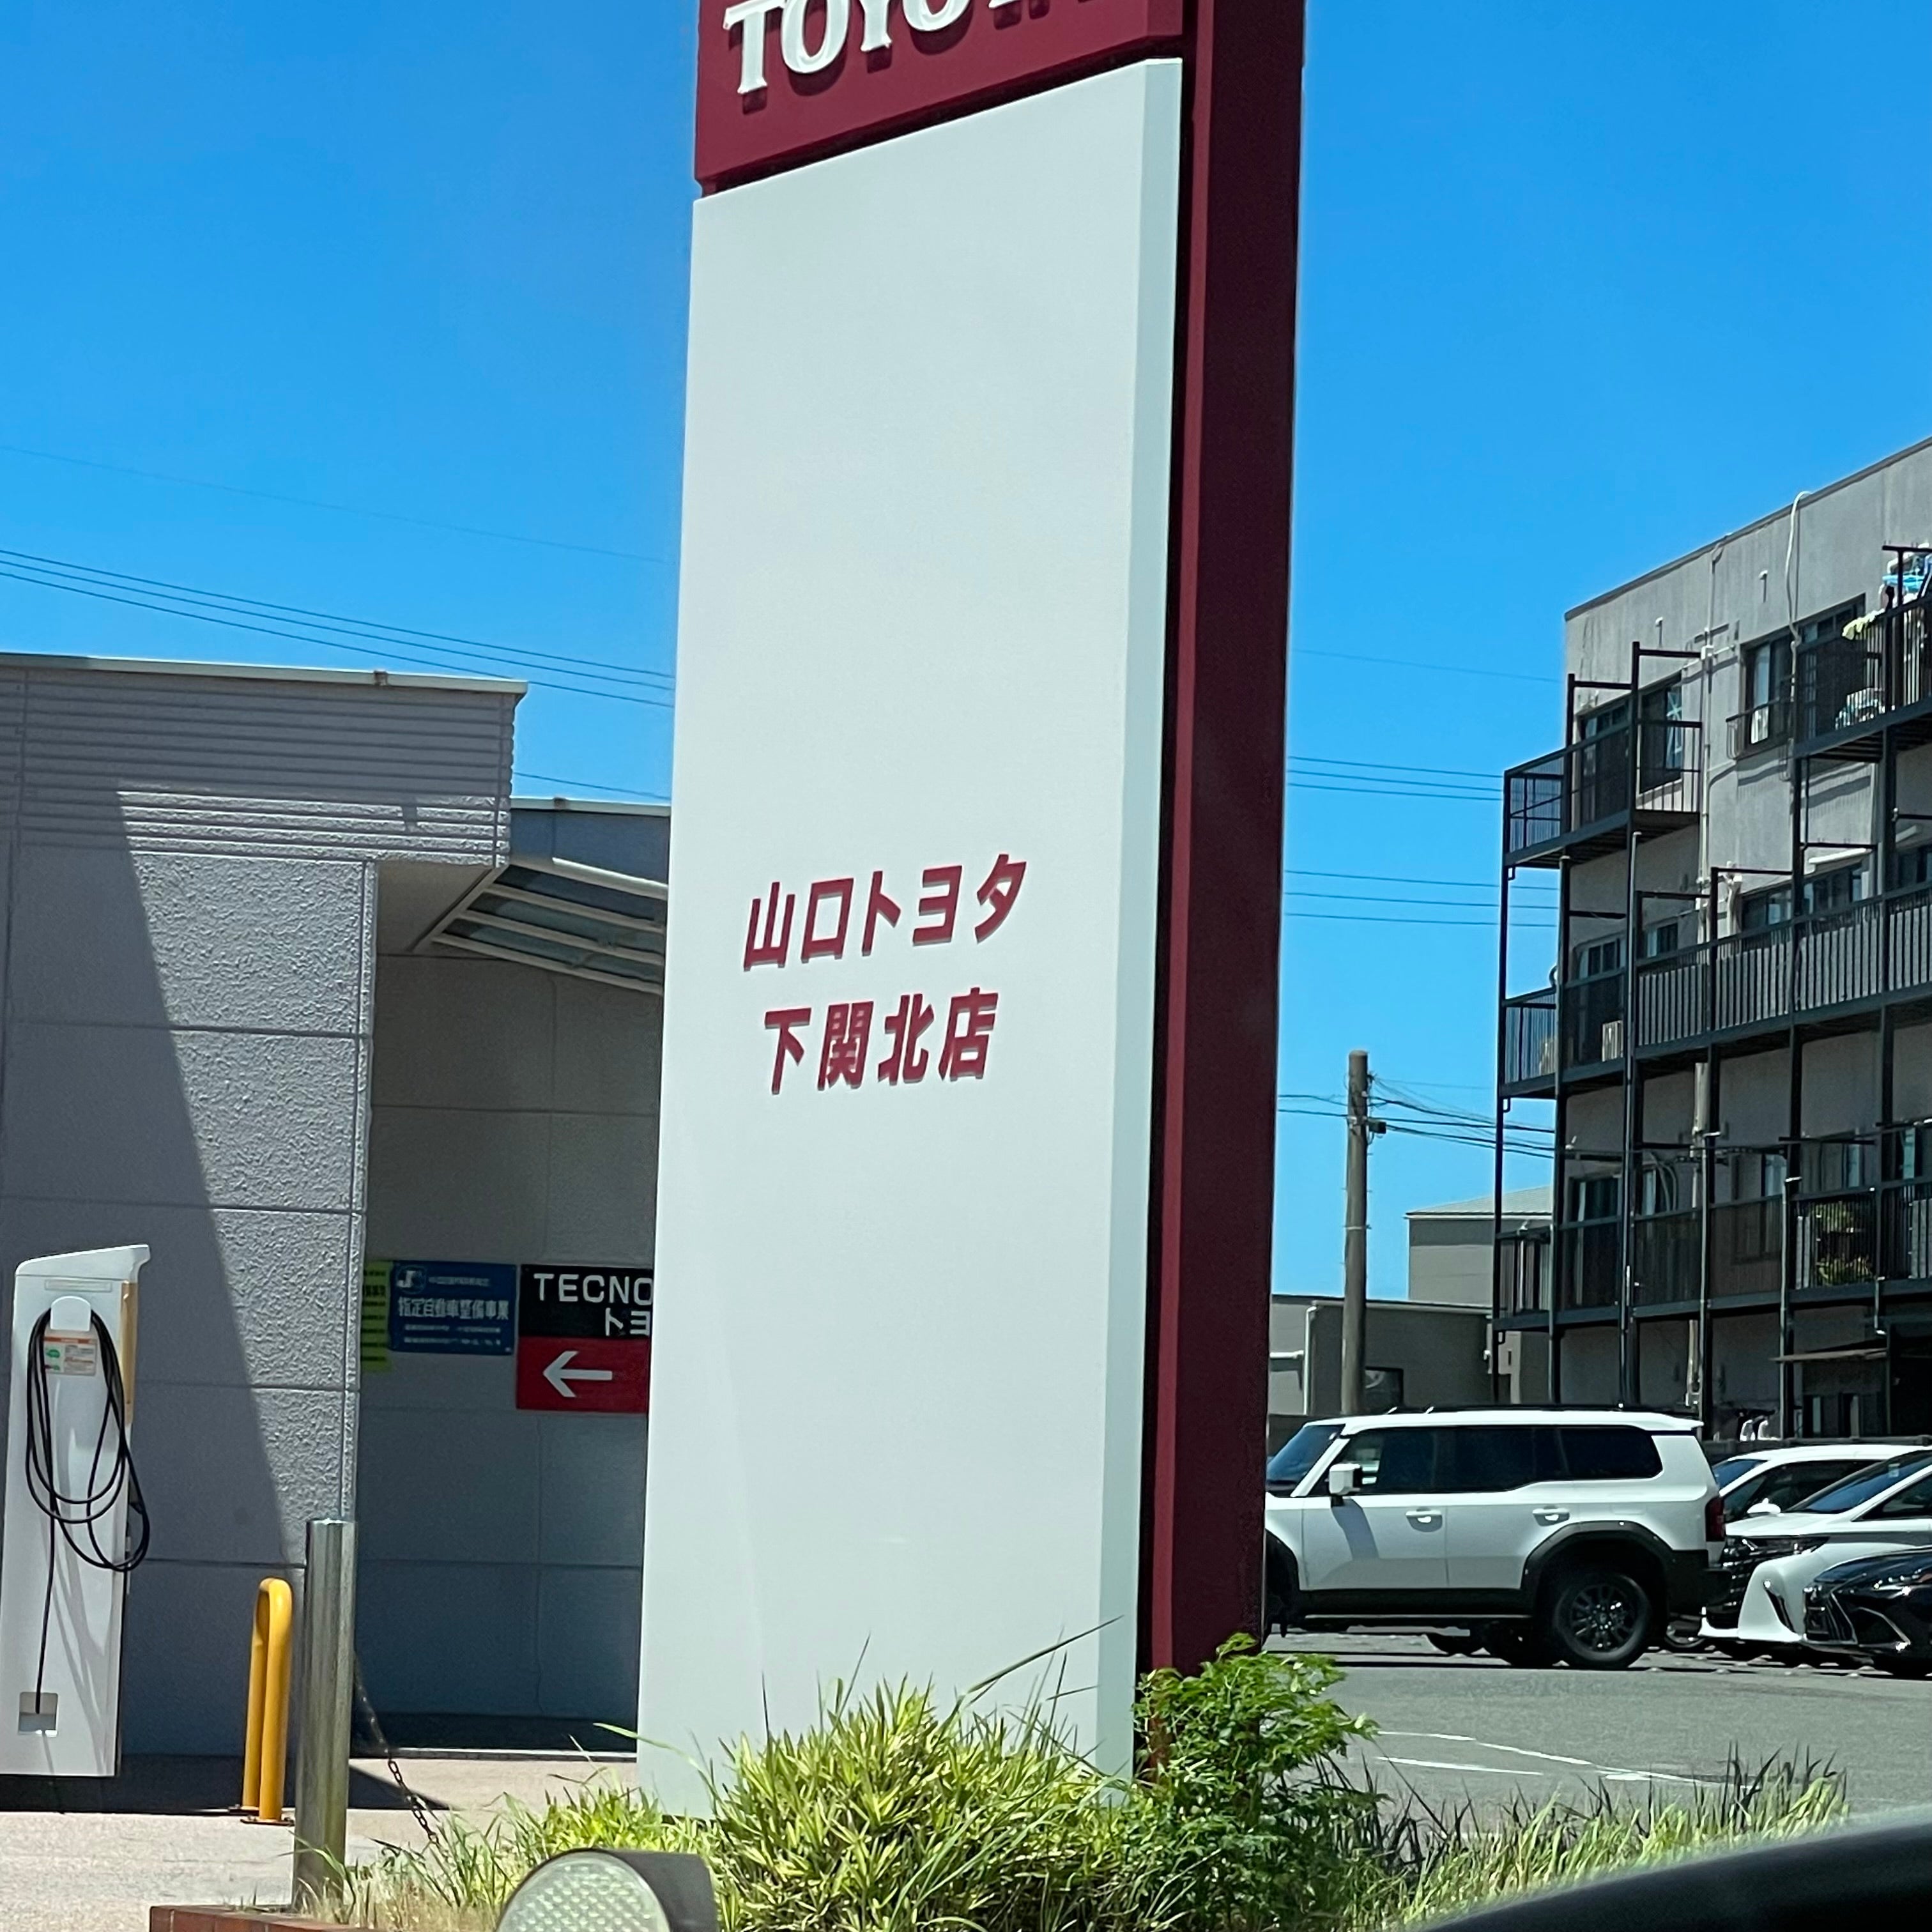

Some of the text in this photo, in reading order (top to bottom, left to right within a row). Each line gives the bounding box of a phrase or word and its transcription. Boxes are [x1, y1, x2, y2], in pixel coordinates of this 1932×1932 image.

[744, 854, 1027, 972] 山口トヨタ
[764, 987, 999, 1094] 下関北店
[533, 1273, 653, 1306] TECNO
[605, 1307, 650, 1337] トヨ
